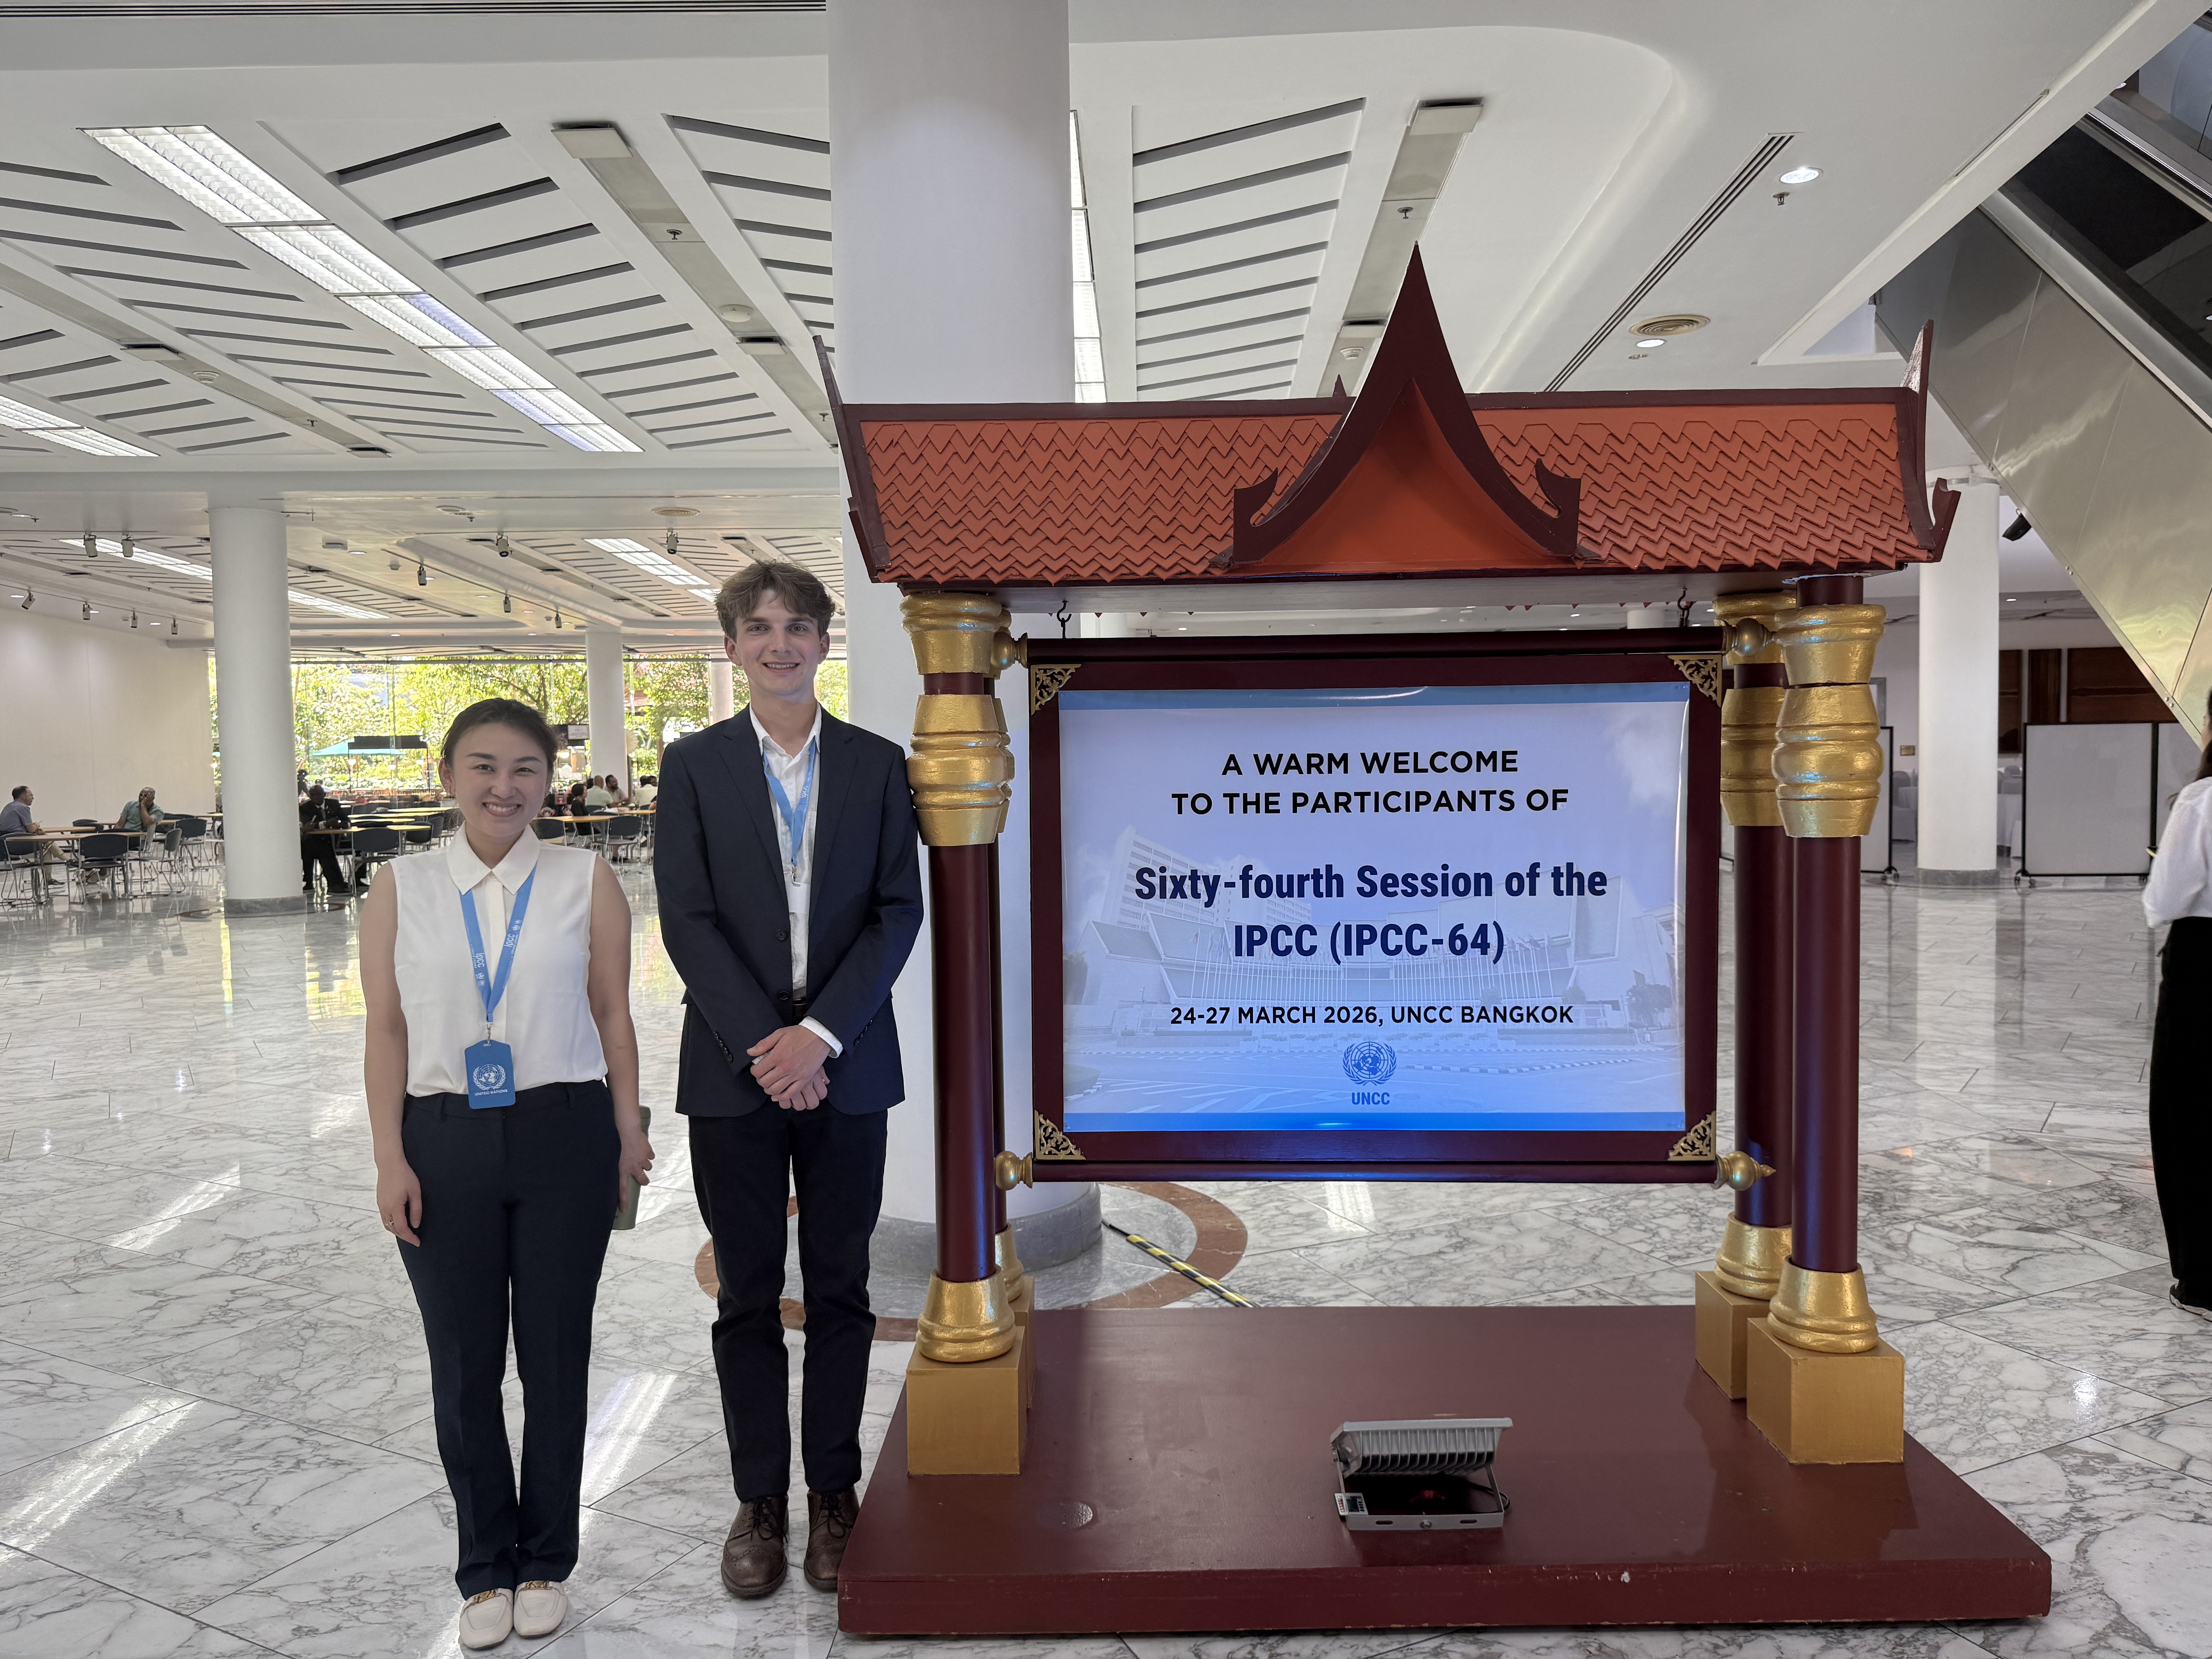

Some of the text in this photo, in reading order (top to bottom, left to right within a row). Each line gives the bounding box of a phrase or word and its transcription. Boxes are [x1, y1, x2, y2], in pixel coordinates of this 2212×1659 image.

[1221, 750, 1518, 776] A WARM WELCOME
[1171, 789, 1568, 815] TO THE PARTICIPANTS OF
[1135, 862, 1607, 908] Sixty-fourth Session of the
[1235, 921, 1504, 965] IPCC (IPCC-64)
[1171, 1006, 1574, 1027] 24-27 MARCH 2026, UNCC BANGKOK
[1352, 1092, 1390, 1105] UNCC
